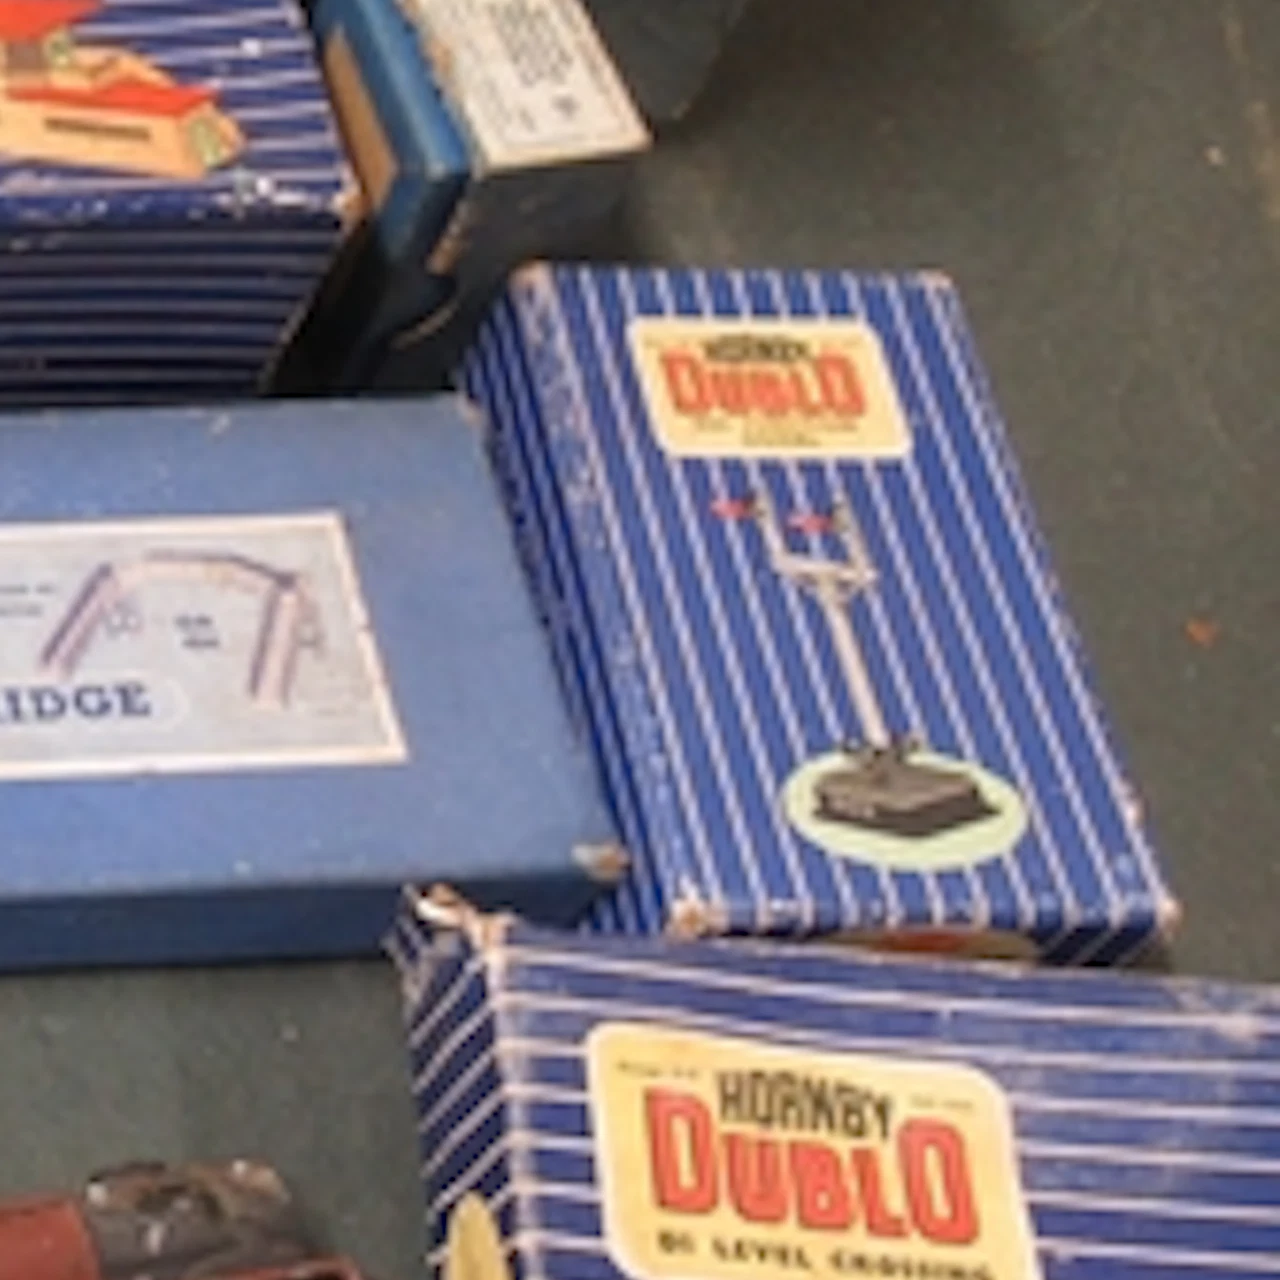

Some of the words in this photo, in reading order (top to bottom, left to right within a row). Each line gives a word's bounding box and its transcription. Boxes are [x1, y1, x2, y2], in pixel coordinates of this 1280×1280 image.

[659, 350, 868, 417] DUBLO
[715, 1068, 896, 1141] HORNBY
[643, 1086, 981, 1247] DUBLO
[711, 1236, 812, 1271] LEVEL
